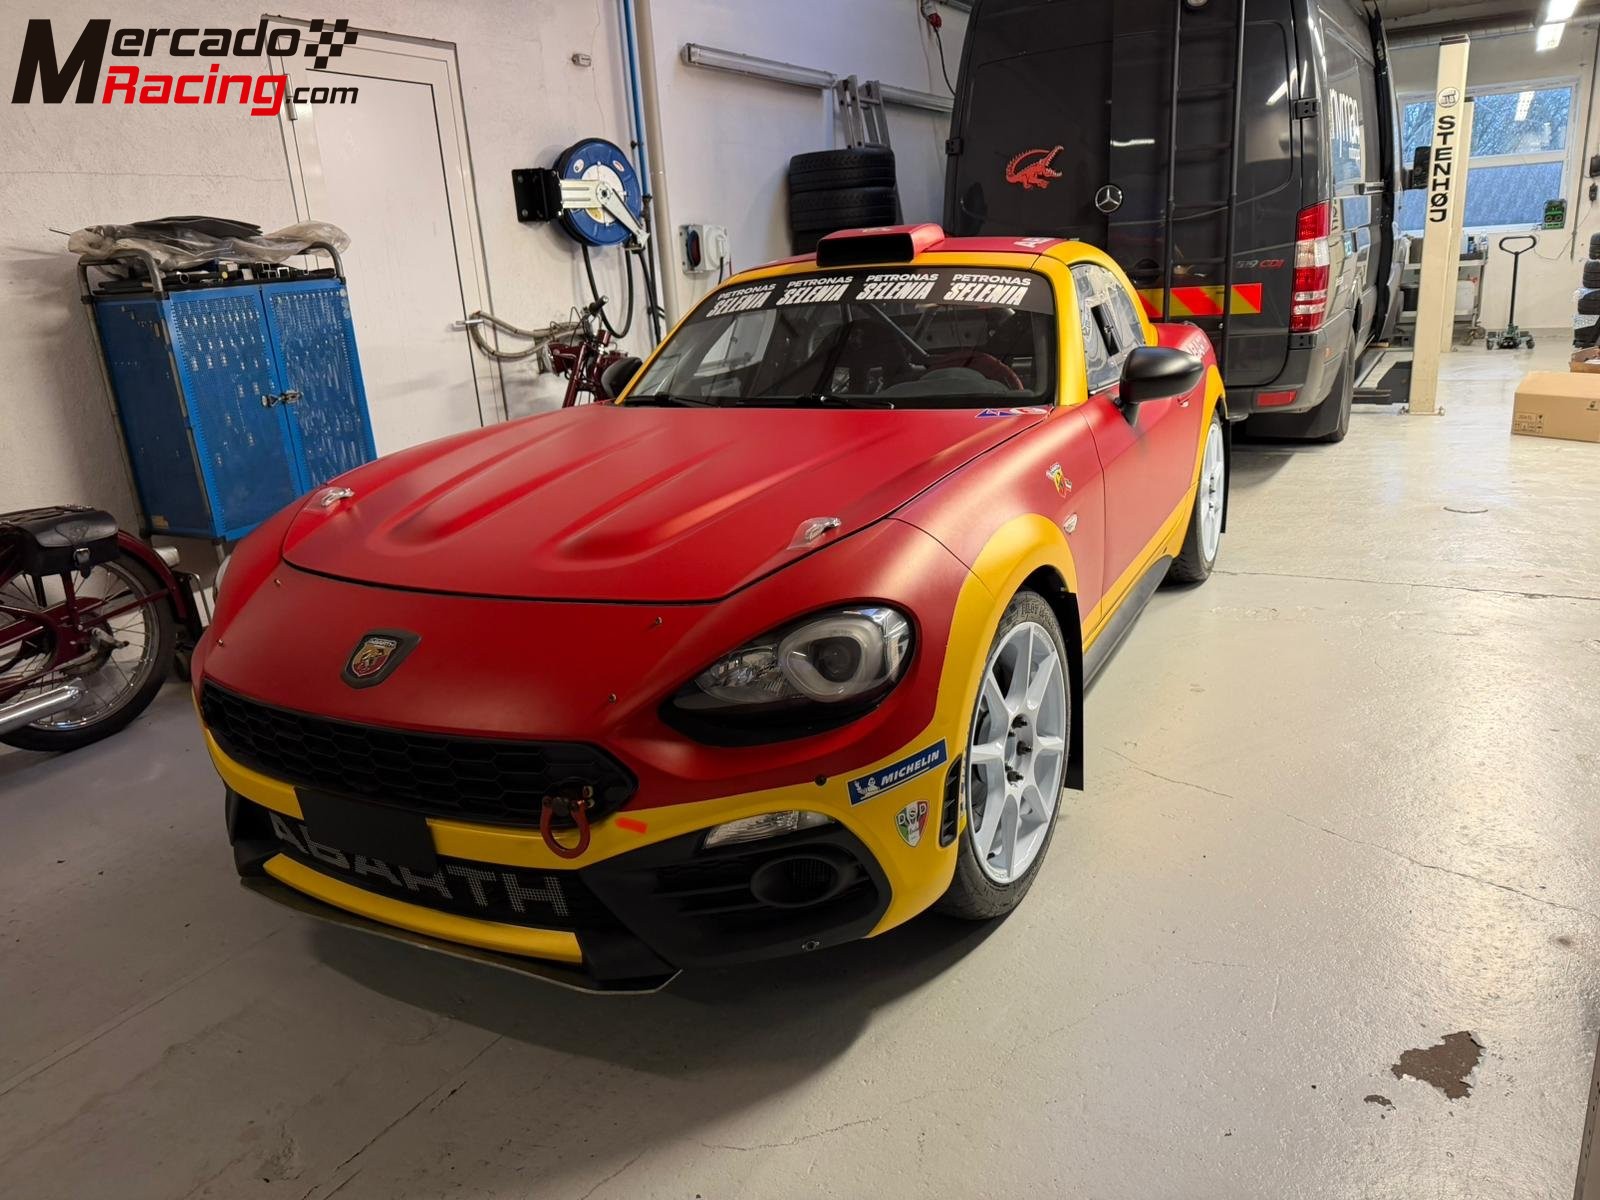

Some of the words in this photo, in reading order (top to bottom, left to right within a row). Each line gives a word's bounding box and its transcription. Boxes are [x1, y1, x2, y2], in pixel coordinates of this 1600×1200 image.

[1429, 115, 1456, 223] STENHØJ
[786, 275, 854, 289] PETRONAS
[865, 273, 939, 283] PETRONAS
[952, 273, 1032, 287] PETRONAS
[717, 283, 777, 301] PETRONAS
[775, 283, 850, 306] SELENIA
[855, 281, 936, 301] SELENIA
[943, 282, 1029, 306] SELENIA
[706, 291, 773, 318] SELENIA
[881, 749, 940, 786] MICHELIN
